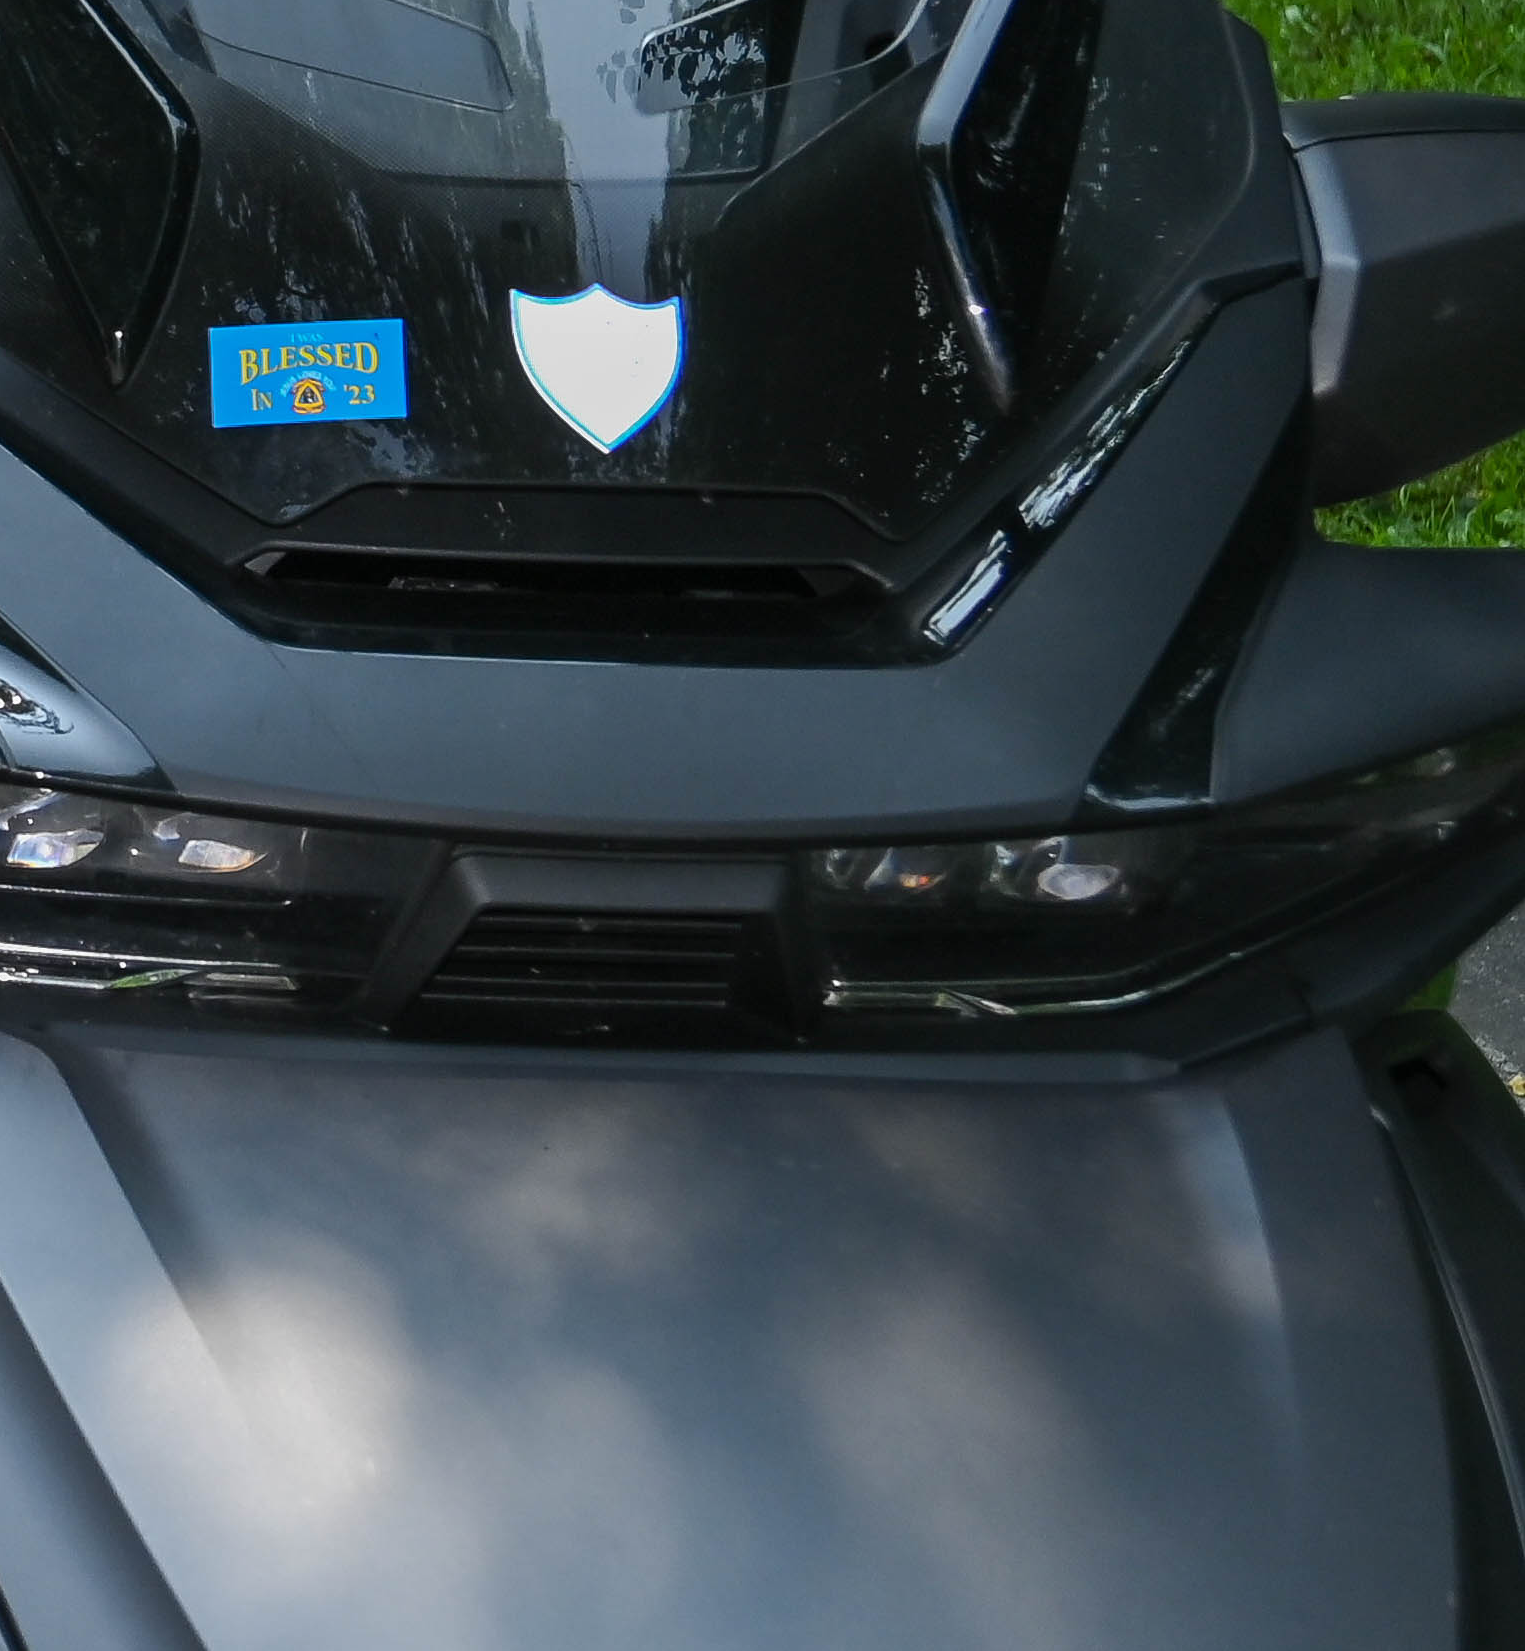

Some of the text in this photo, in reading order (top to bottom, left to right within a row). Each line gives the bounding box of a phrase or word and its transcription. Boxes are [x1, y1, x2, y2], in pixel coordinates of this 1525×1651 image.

[239, 341, 380, 386] BLESSED
[251, 383, 377, 411] IN '23
